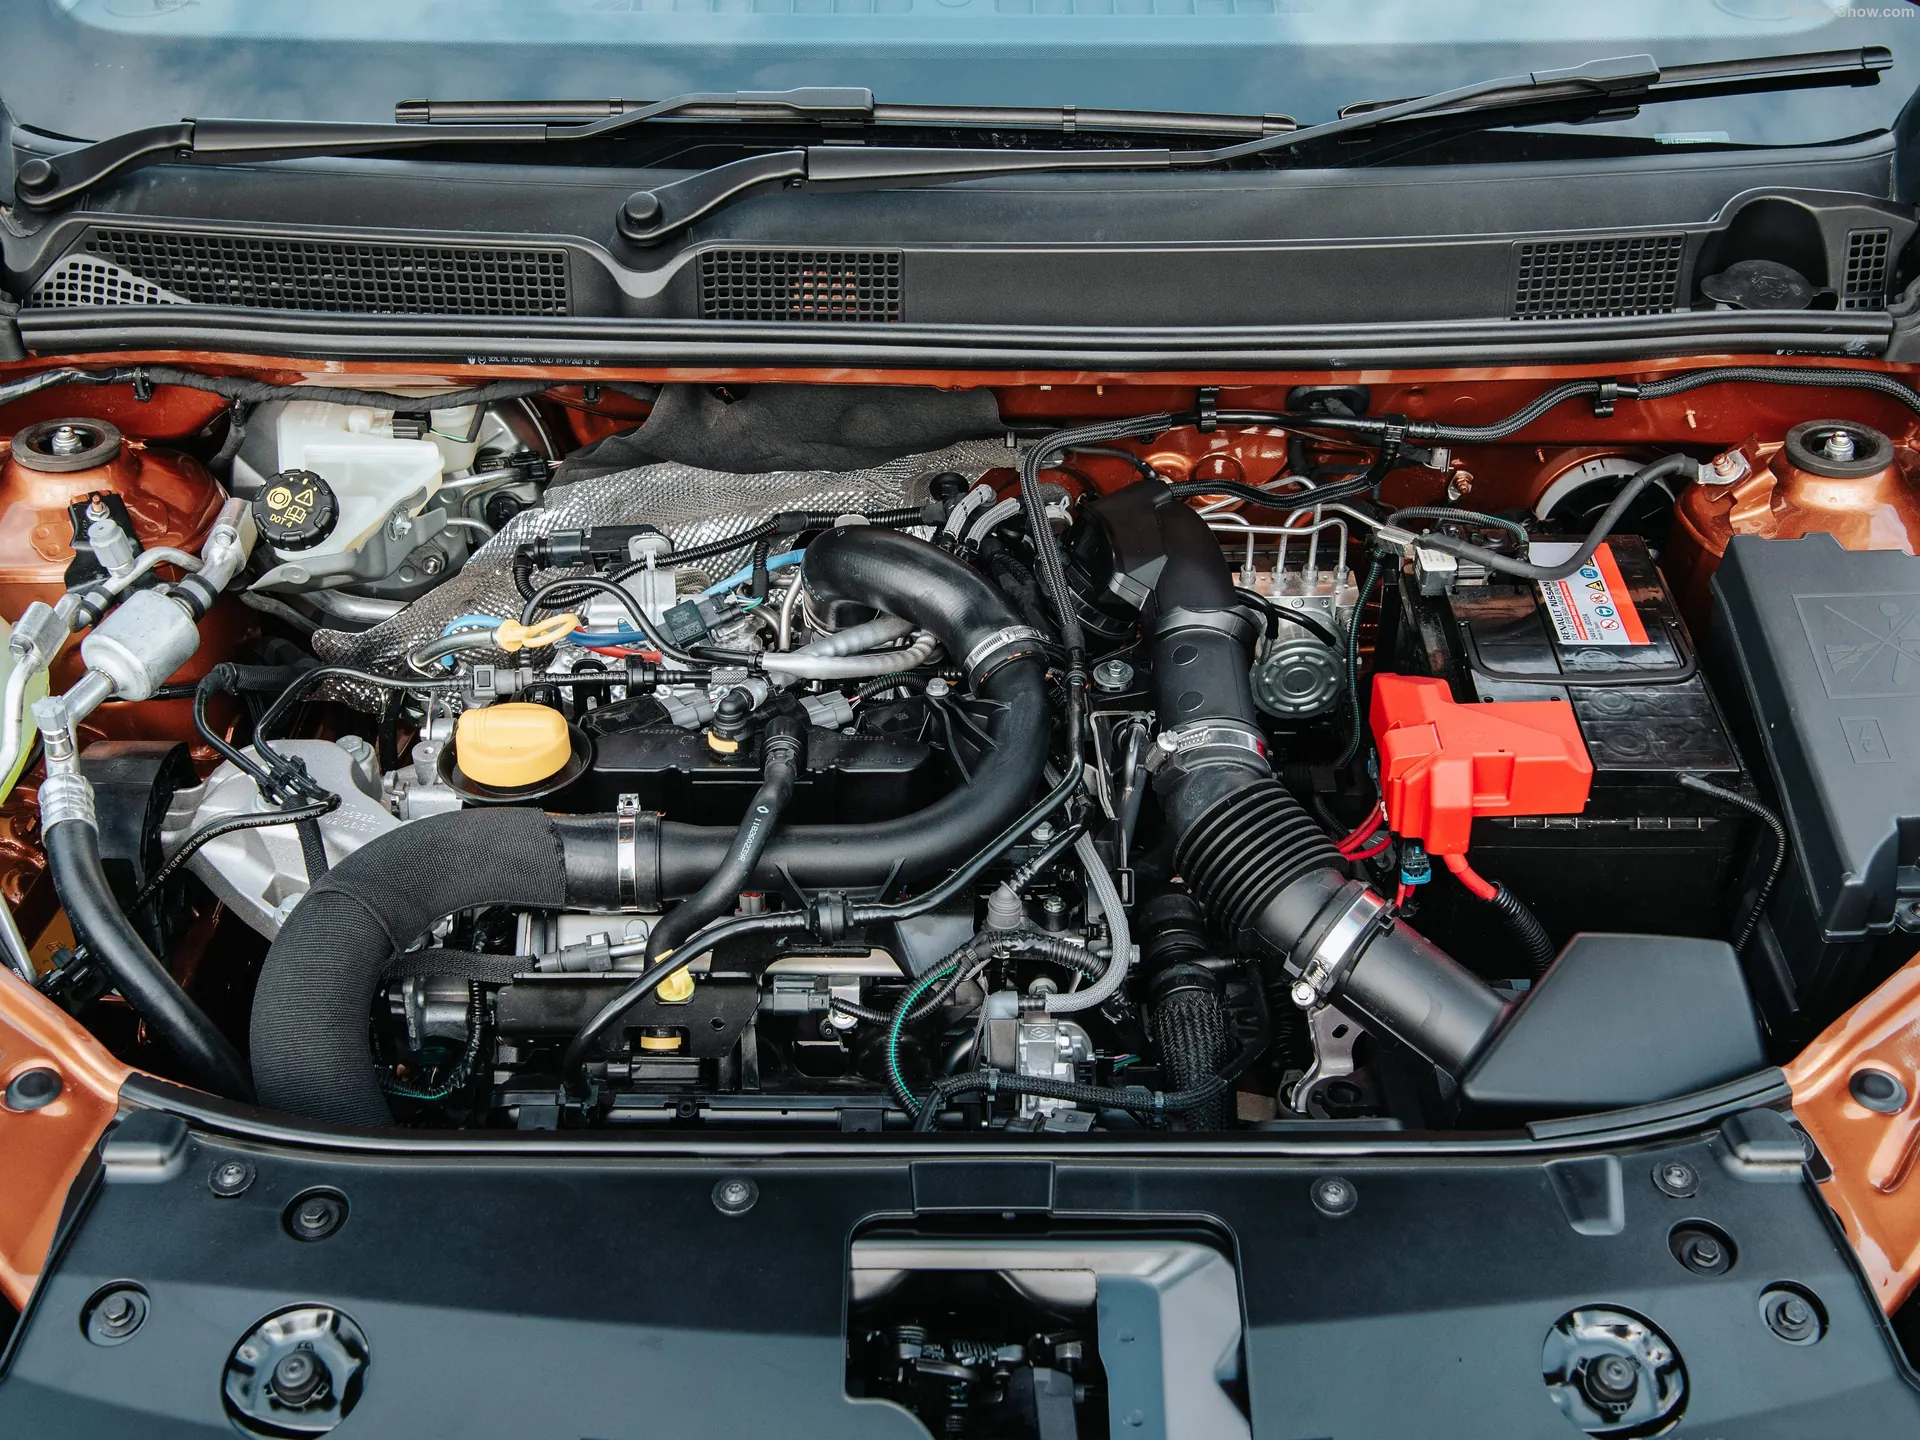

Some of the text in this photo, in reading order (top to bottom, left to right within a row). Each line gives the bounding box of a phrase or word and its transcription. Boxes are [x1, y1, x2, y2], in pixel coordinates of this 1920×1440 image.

[269, 513, 293, 529] DOT 4
[1542, 581, 1571, 640] RENAULT NISSAN
